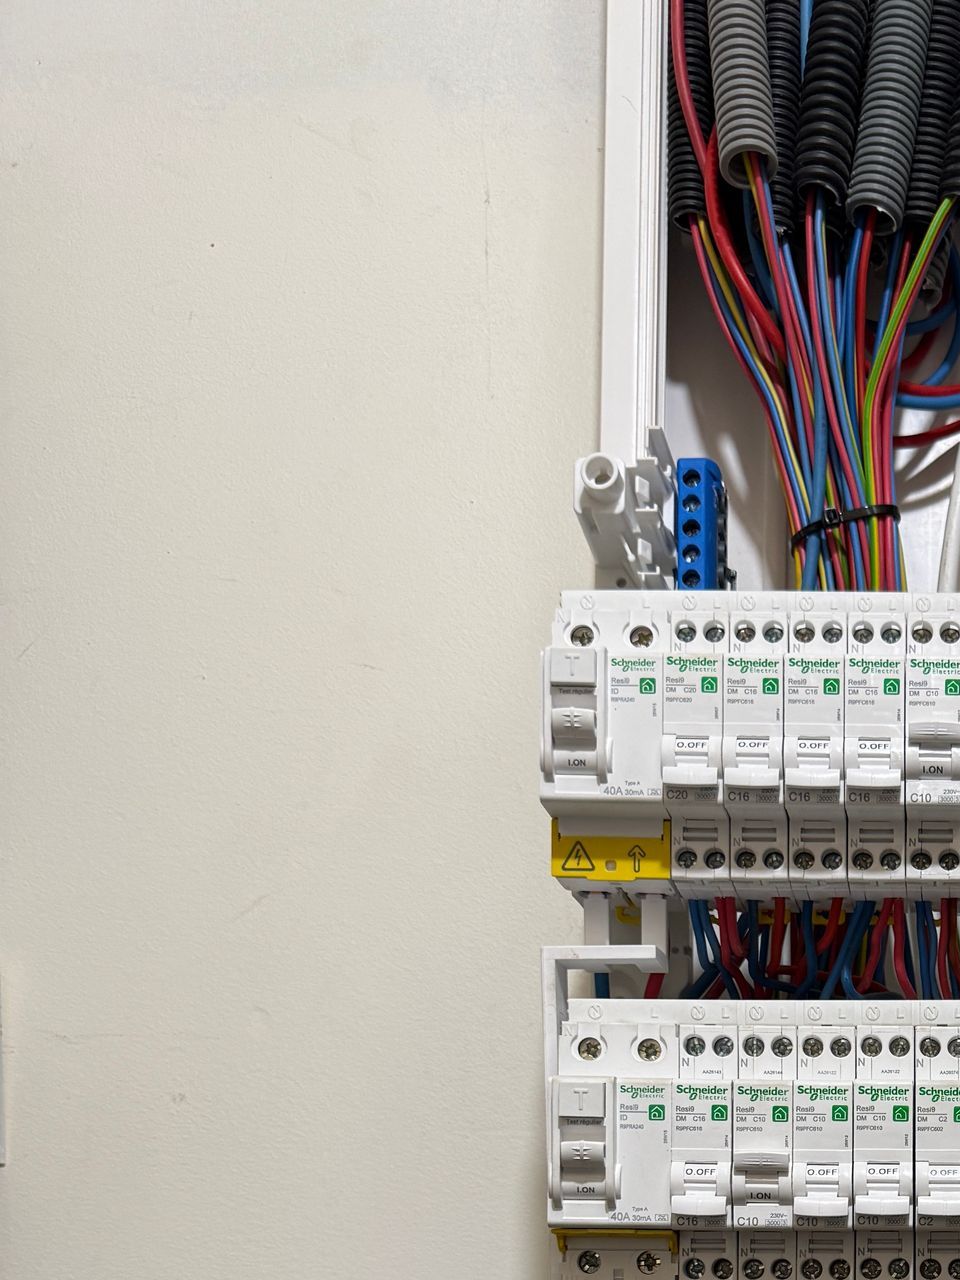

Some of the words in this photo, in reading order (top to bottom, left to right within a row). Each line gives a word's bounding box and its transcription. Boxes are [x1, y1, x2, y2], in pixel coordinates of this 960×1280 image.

[674, 643, 682, 652] N
[733, 644, 741, 652] N
[793, 644, 800, 652] N
[851, 644, 859, 653] N
[909, 645, 916, 653] N
[611, 658, 656, 667] Schneider
[666, 656, 718, 667] Schneider
[727, 657, 780, 668] Schneider
[788, 658, 841, 668] Schneider
[849, 658, 901, 668] Schneider
[665, 676, 685, 684] Resi9
[676, 741, 707, 749] O.OFF
[568, 759, 586, 767] I.ON
[923, 765, 944, 774] I.ON
[603, 787, 624, 796] 40A
[666, 789, 689, 800] C20
[728, 791, 750, 801] C16
[789, 791, 811, 802] C16
[849, 792, 871, 802] C16
[910, 793, 932, 803] C10
[673, 838, 681, 847] N
[733, 838, 741, 847] N
[792, 838, 800, 847] N
[850, 838, 858, 847] N
[909, 838, 917, 847] N
[682, 1058, 690, 1067] N
[740, 1058, 748, 1067] N
[800, 1058, 808, 1067] N
[857, 1058, 865, 1067] N
[916, 1059, 924, 1068] N
[620, 1085, 666, 1094] Schneider
[676, 1084, 729, 1095] Schneider
[737, 1086, 789, 1096] Schneider
[797, 1085, 849, 1095] Schneider
[858, 1085, 910, 1095] Schneider
[685, 1168, 716, 1176] O.OFF
[750, 1192, 771, 1200] I.ON
[610, 1212, 631, 1222] 40A
[676, 1216, 698, 1226] C16
[857, 1215, 879, 1225] C10
[918, 1216, 934, 1226] C2
[737, 1217, 759, 1227] C10
[796, 1217, 818, 1227] C10
